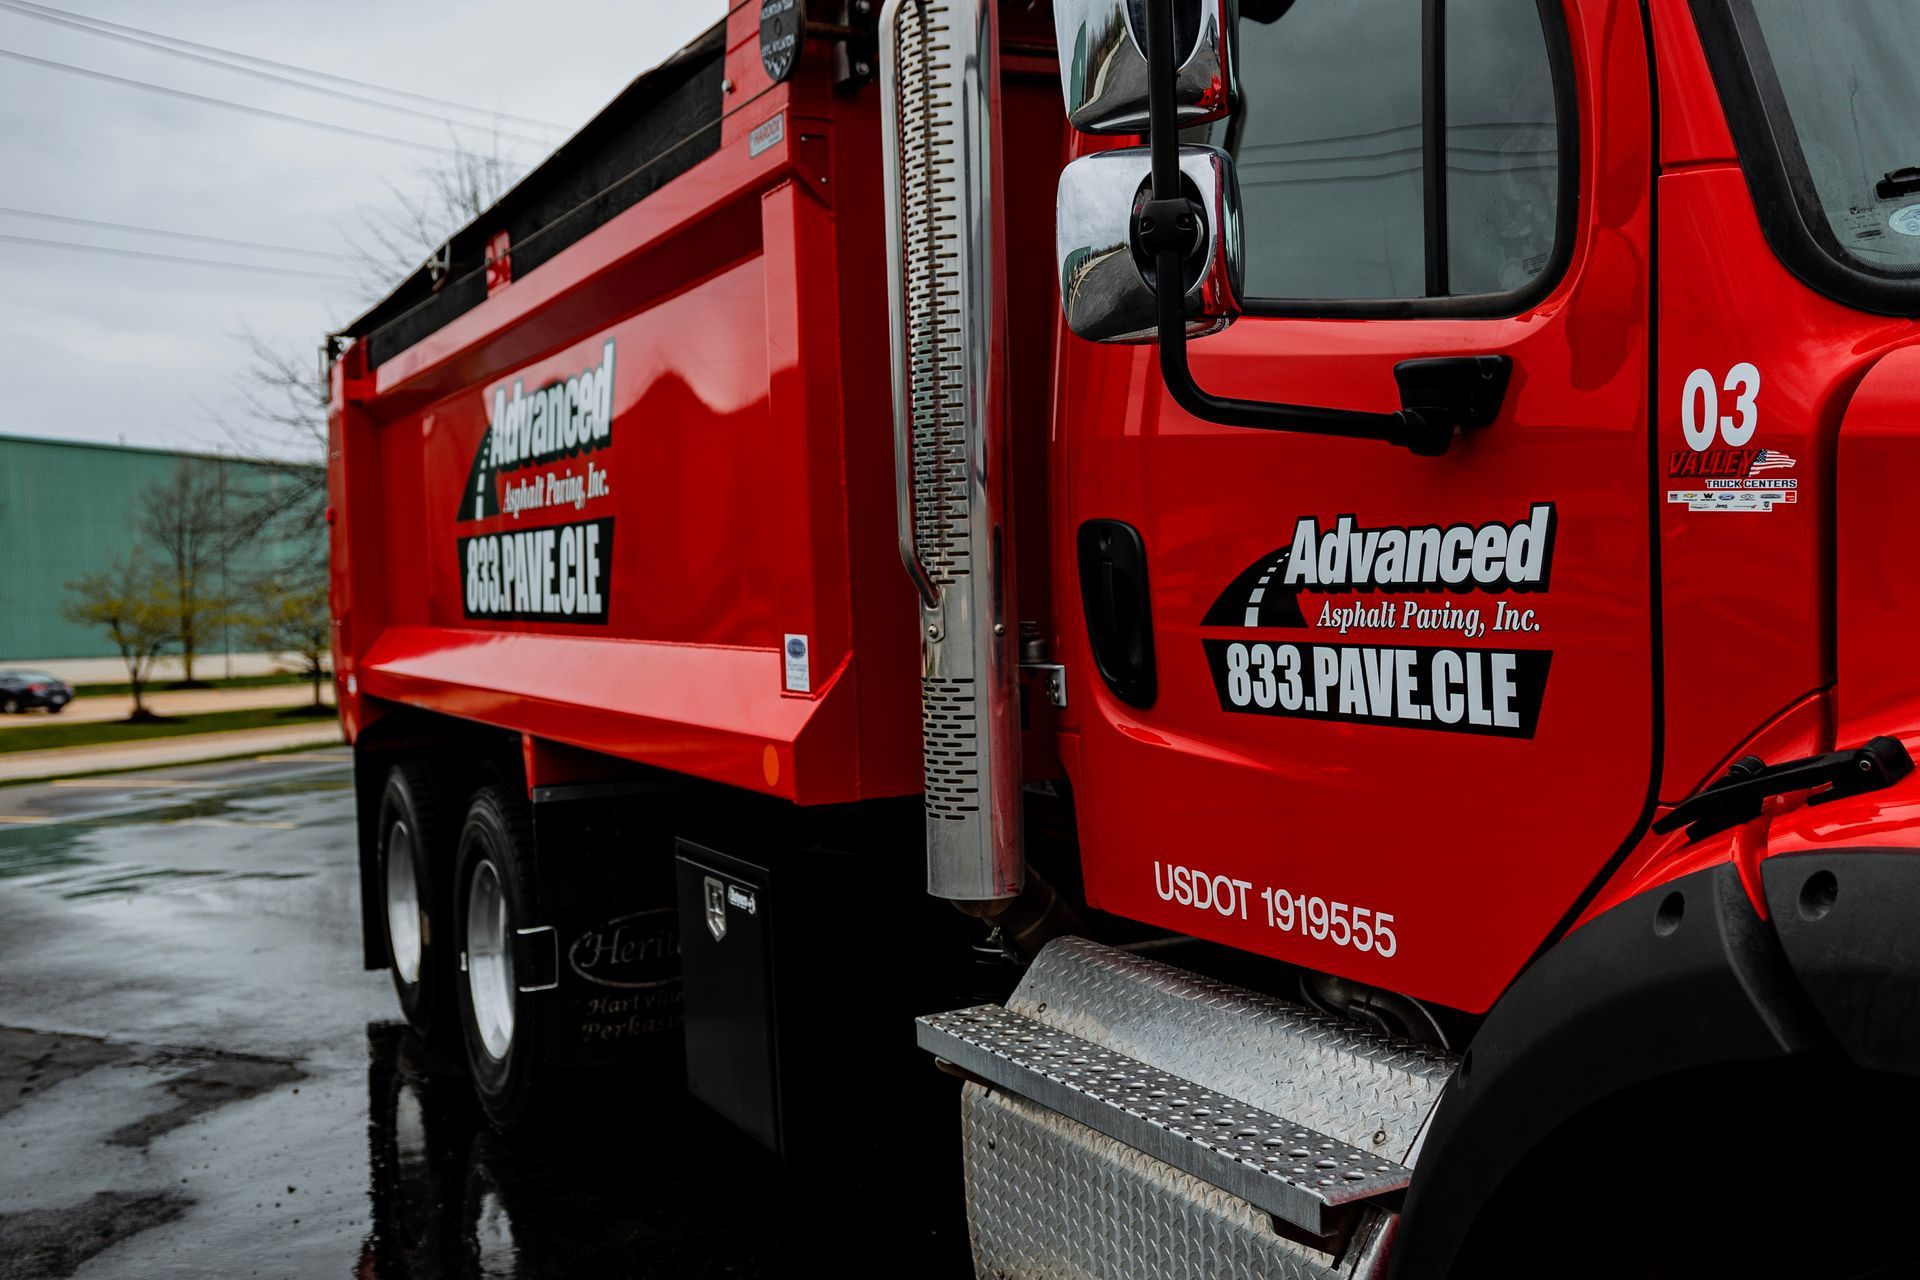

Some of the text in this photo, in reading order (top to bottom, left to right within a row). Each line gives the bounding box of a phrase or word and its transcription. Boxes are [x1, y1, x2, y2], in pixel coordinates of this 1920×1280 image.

[490, 341, 615, 468] Advanced
[1681, 362, 1760, 452] 03
[503, 475, 544, 519] Asphalt
[587, 462, 609, 499] Inc.
[1669, 450, 1758, 478] VALLEY
[1706, 479, 1797, 488] TRUCK CENTERS
[466, 523, 603, 616] 833.PAVE.CLE
[1283, 505, 1551, 586] Advanced
[1316, 600, 1541, 638] Asphalt Paving, Inc.
[1226, 642, 1520, 729] 833.PAVE.CLE
[1154, 861, 1398, 958] USDOT 1919555
